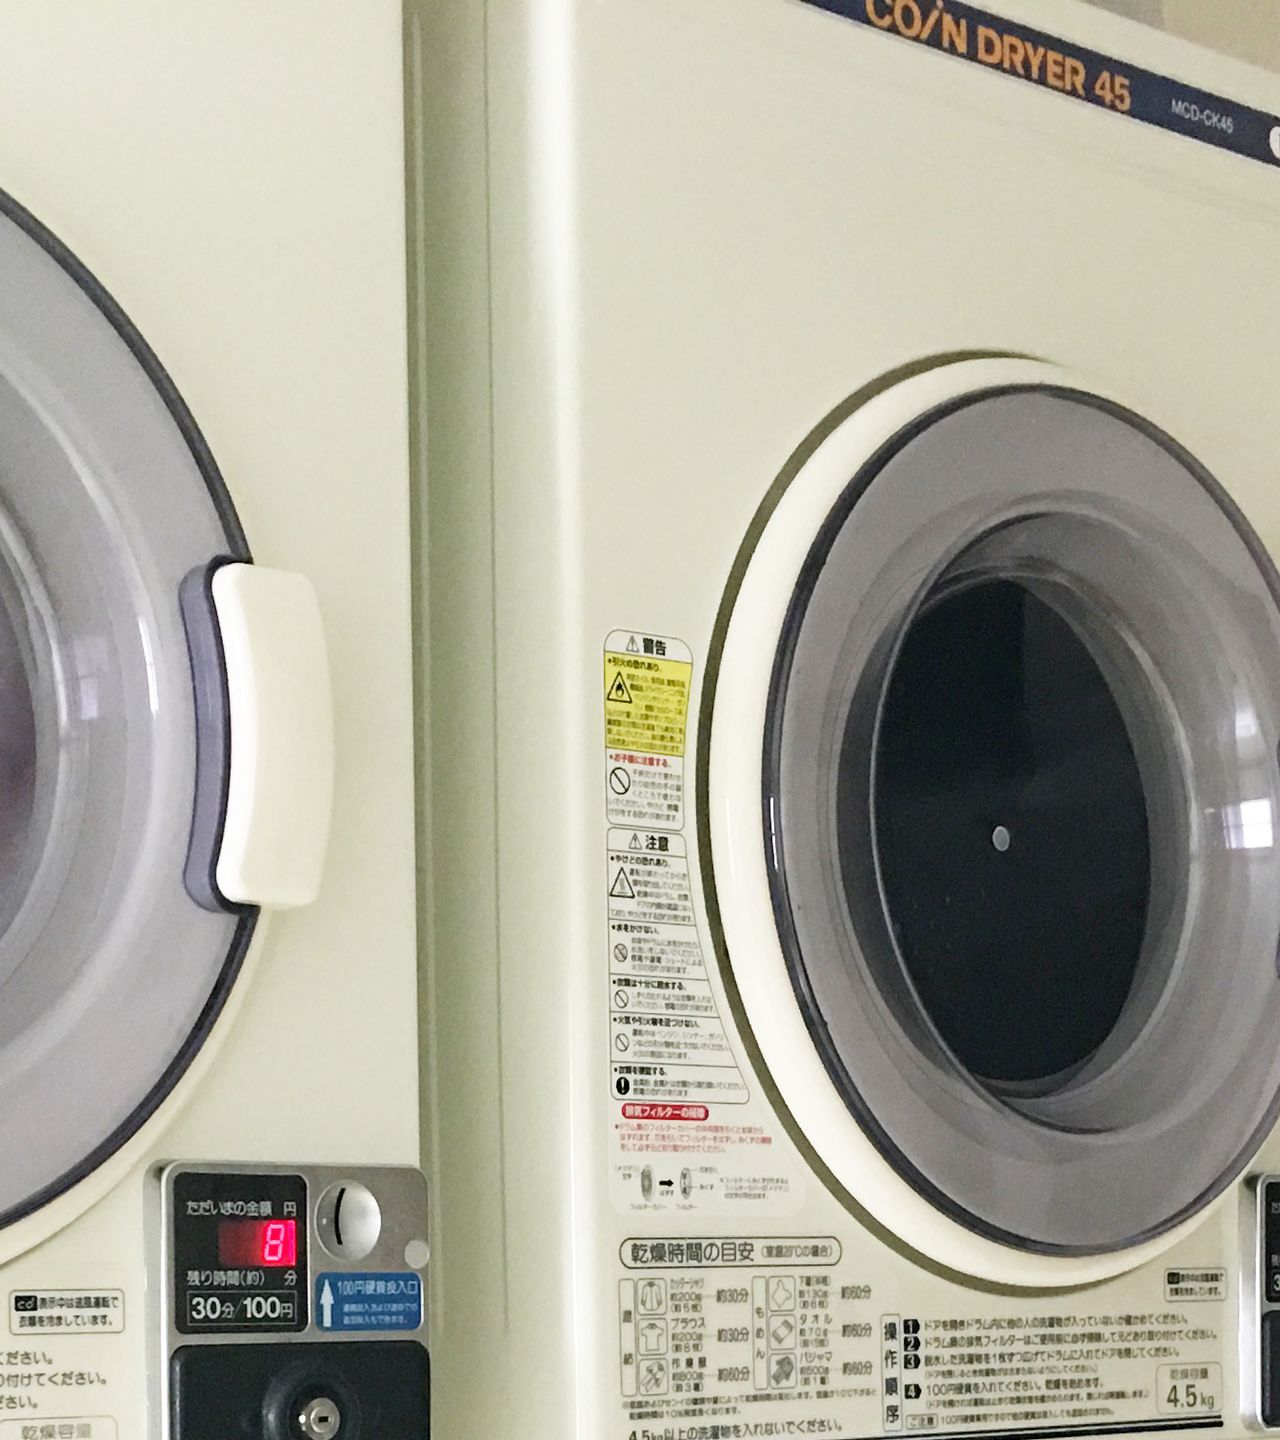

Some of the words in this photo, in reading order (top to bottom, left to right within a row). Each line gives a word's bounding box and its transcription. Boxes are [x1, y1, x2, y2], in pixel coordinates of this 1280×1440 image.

[977, 25, 1086, 96] DRYER
[1094, 70, 1131, 112] 45
[1172, 98, 1233, 134] MCD-CK45
[643, 637, 666, 656] 警告
[645, 834, 669, 851] 注意
[186, 1201, 273, 1217] ただいまの金額
[283, 1202, 297, 1217] 円
[263, 1224, 285, 1261] 8
[631, 1242, 754, 1263] 乾燥時間の目安
[284, 1272, 298, 1286] 分
[884, 1322, 900, 1424] 操作順序
[1167, 1384, 1196, 1409] 4.5
[1200, 1392, 1214, 1409] kg
[20, 1423, 92, 1440] 乾燥容量
